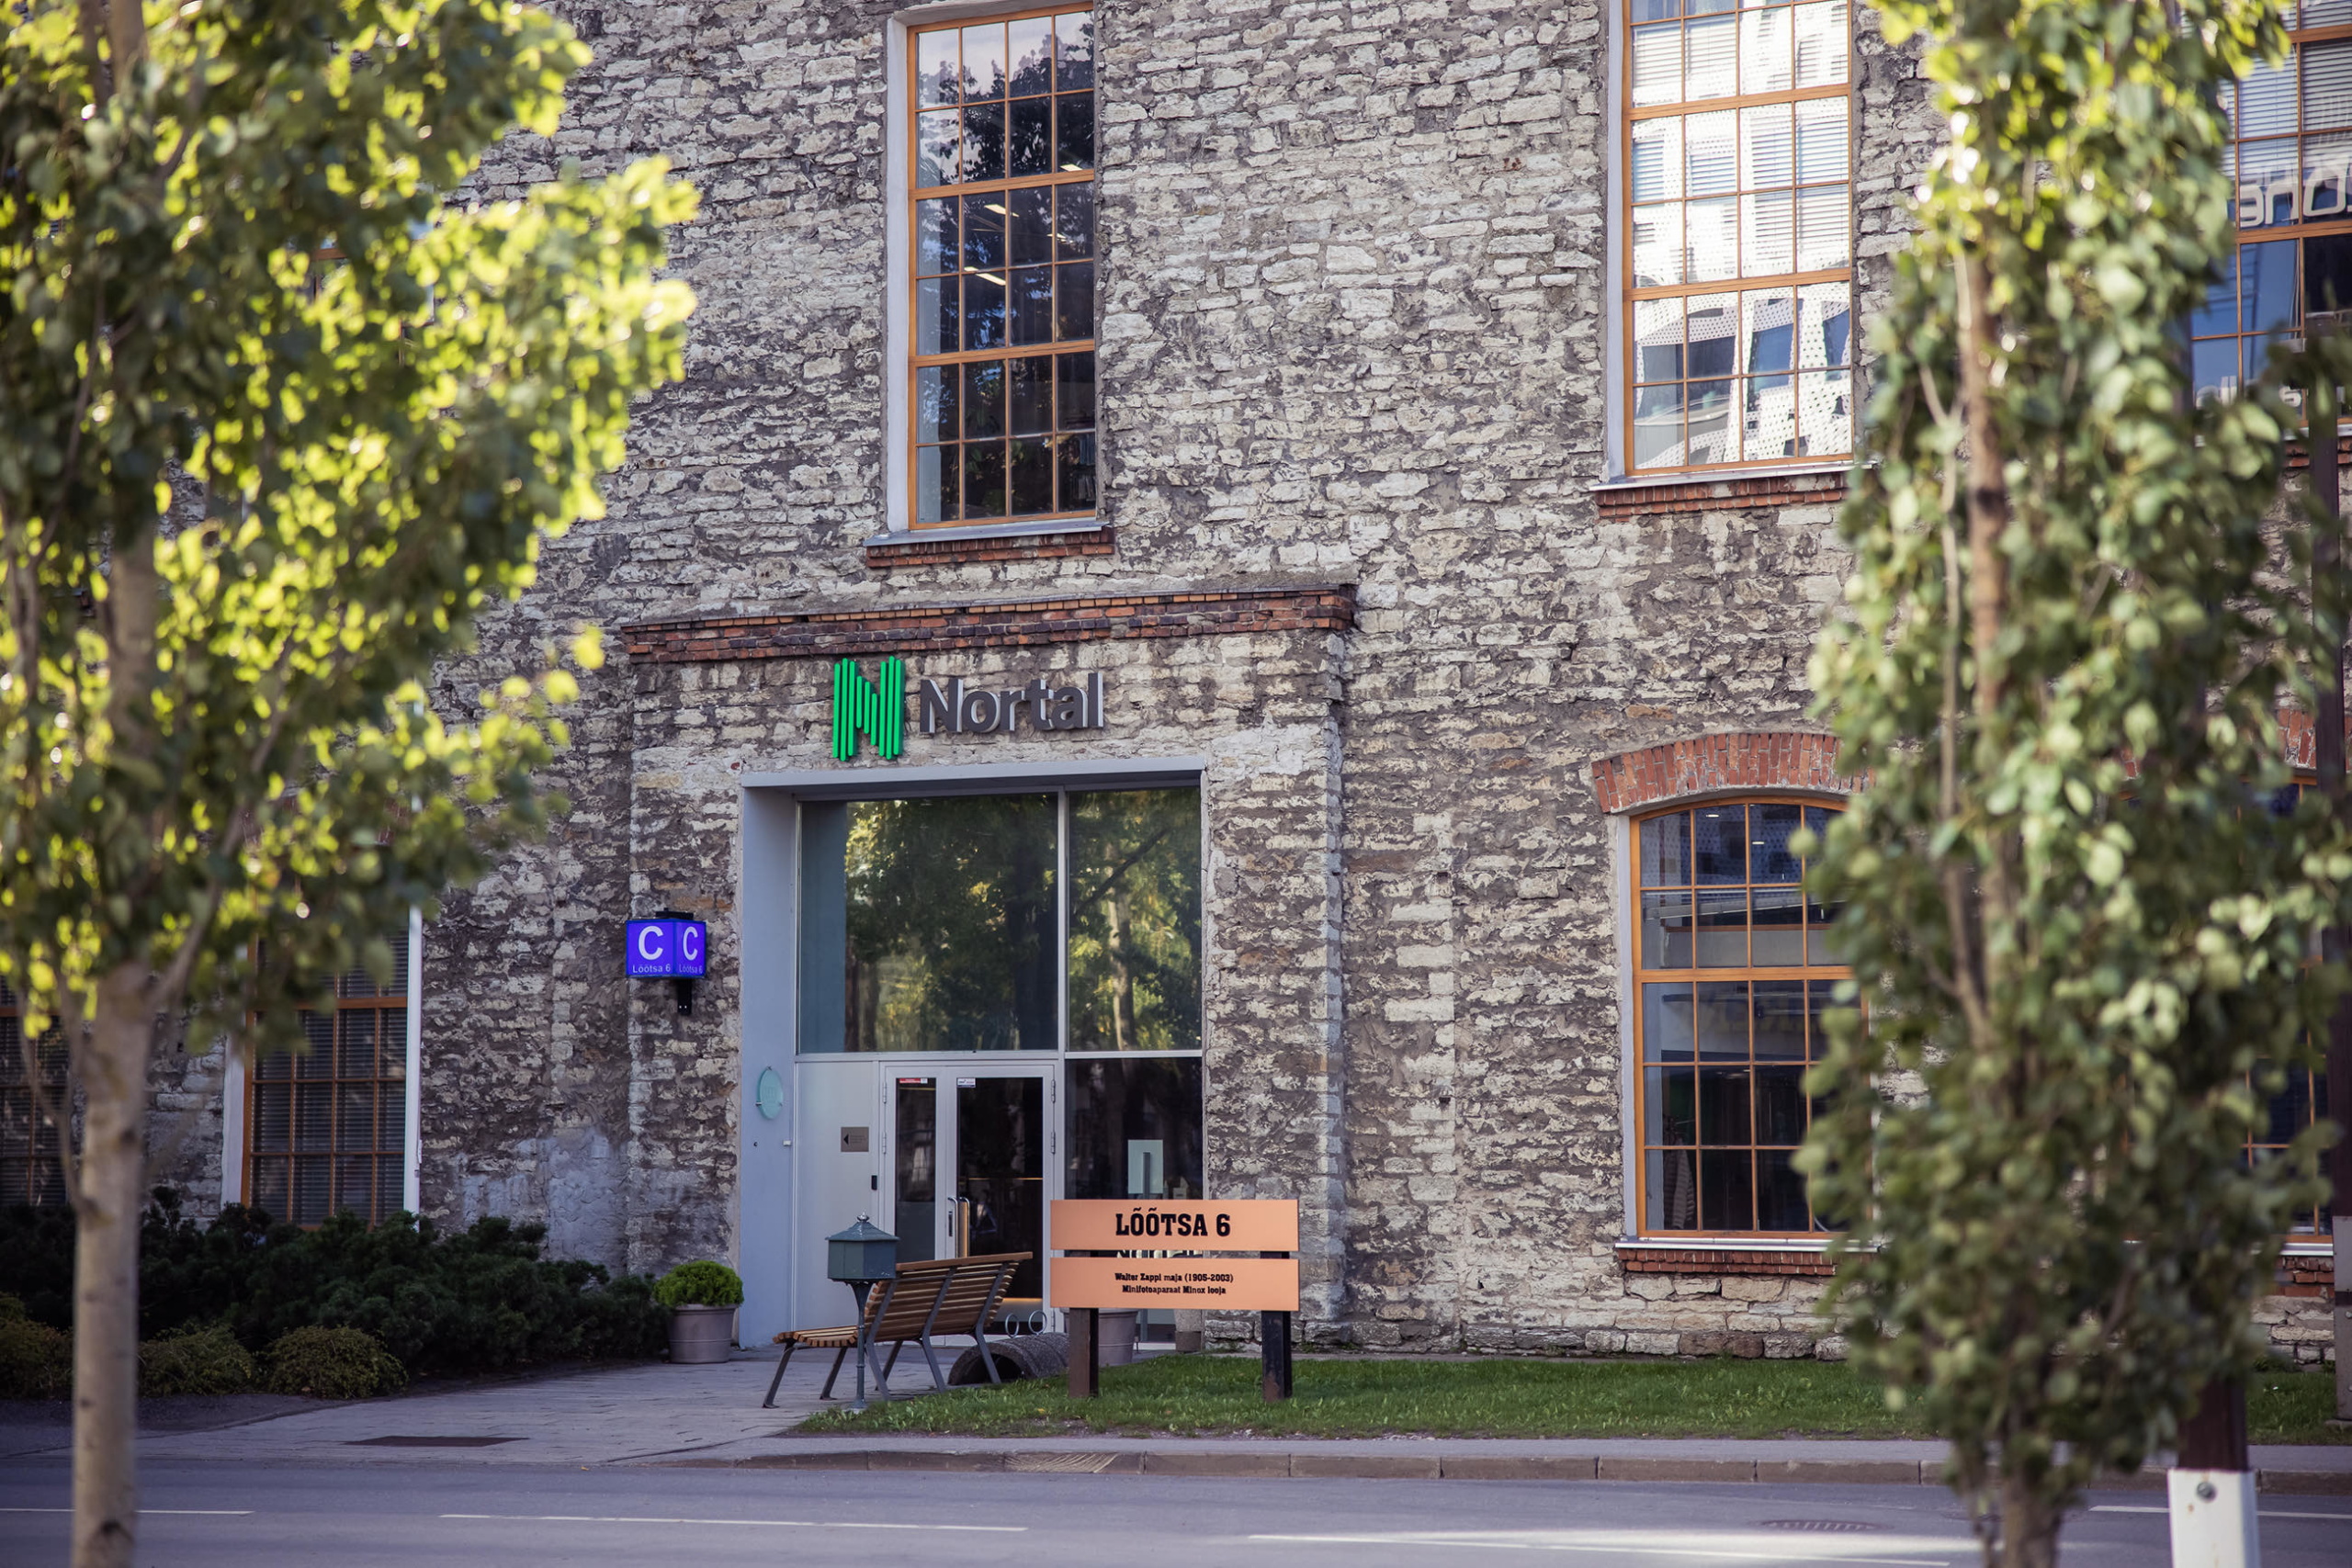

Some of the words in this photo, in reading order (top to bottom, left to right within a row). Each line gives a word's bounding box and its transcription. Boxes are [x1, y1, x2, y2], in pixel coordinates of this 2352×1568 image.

[920, 672, 1103, 733] Nortal
[638, 925, 663, 961] C
[683, 926, 698, 961] C
[665, 964, 671, 973] 6
[1115, 1207, 1208, 1236] LÕÕTSA
[1216, 1213, 1231, 1237] 6
[1114, 1272, 1138, 1281] Walter
[1164, 1273, 1182, 1282] maja
[1184, 1273, 1234, 1283] (1905-2003)
[1122, 1285, 1181, 1295] Minifotoaparaat
[1182, 1285, 1205, 1294] Minox
[1207, 1286, 1227, 1295] looja
